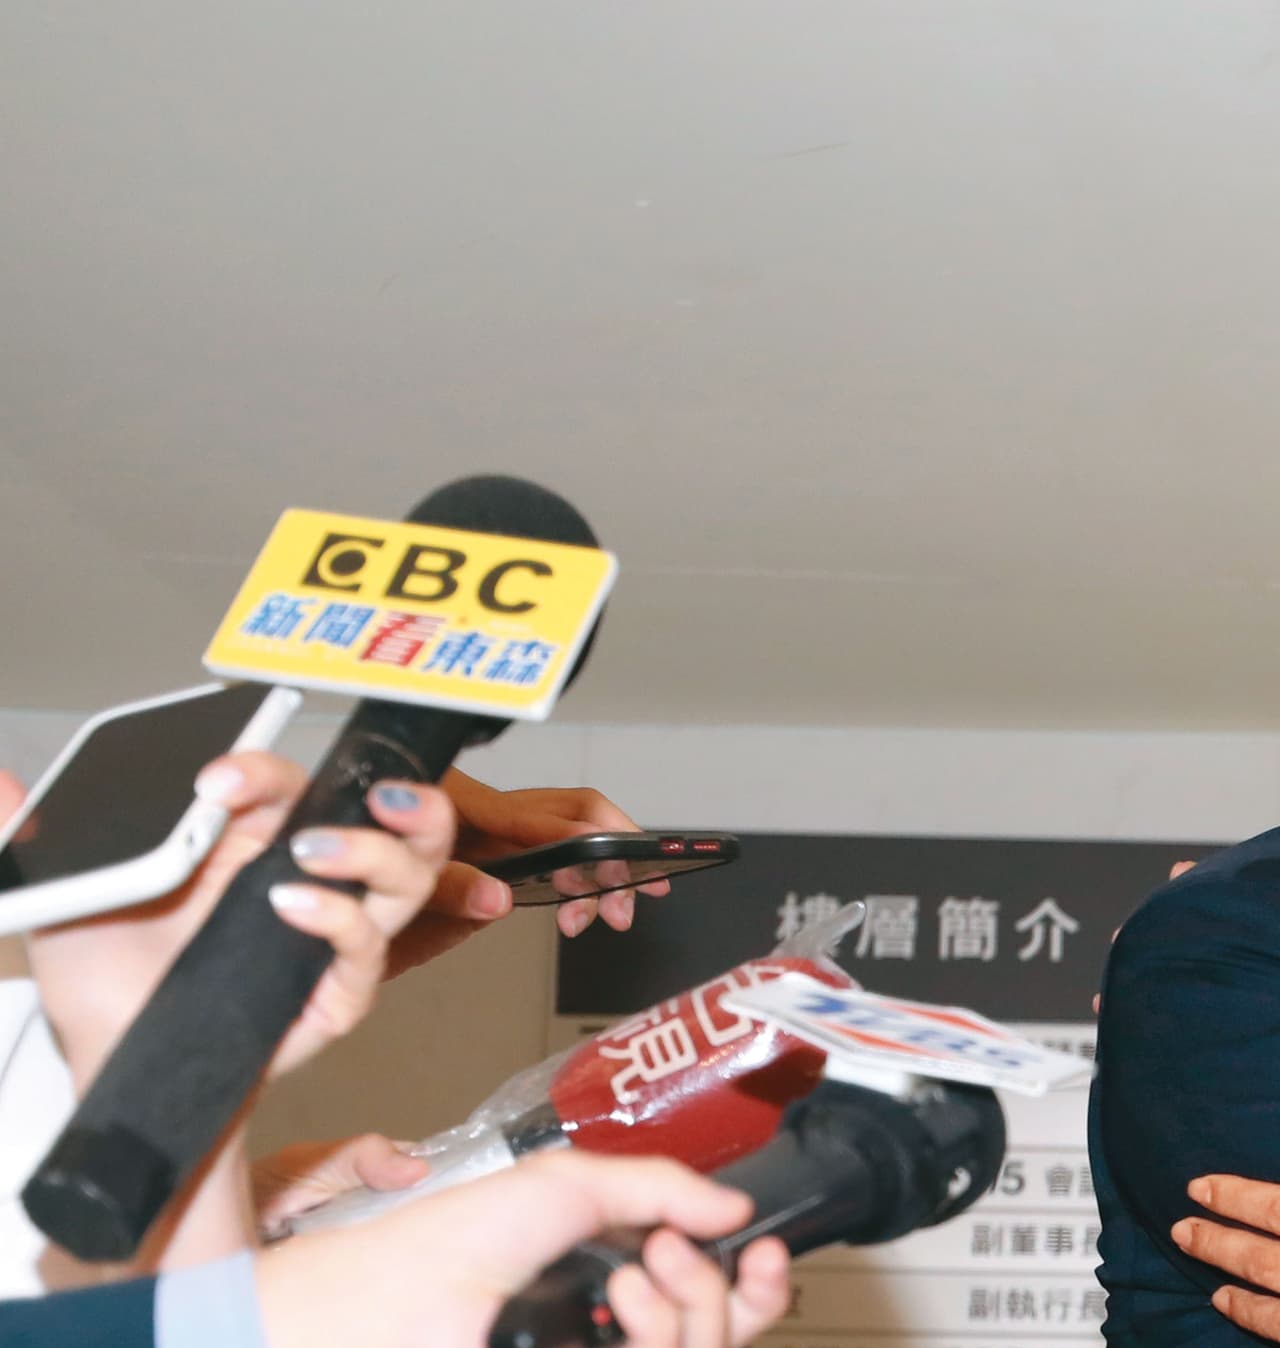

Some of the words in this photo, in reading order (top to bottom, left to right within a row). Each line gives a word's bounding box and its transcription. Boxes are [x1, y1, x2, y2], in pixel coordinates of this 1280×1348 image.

[241, 593, 559, 685] 新聞看東森
